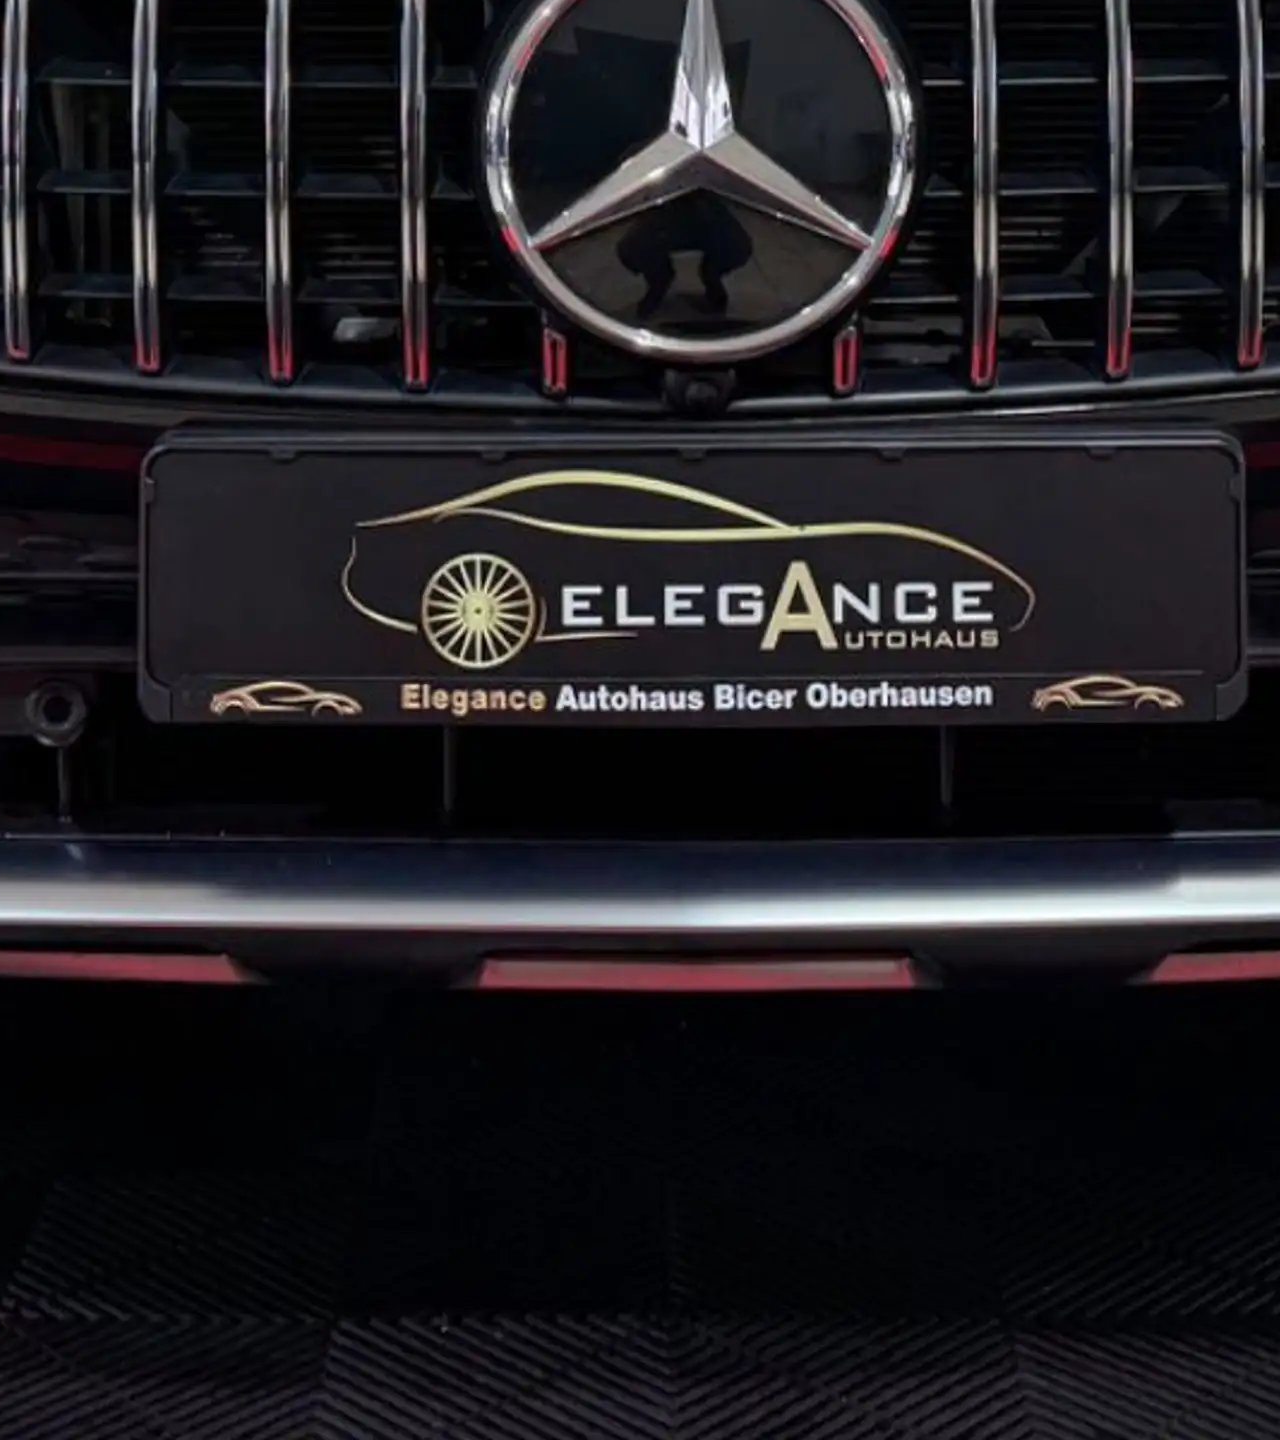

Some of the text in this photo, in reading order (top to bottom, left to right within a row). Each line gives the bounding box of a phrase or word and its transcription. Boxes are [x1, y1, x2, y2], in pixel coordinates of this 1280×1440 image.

[561, 560, 994, 651] ELEGANCE
[400, 681, 994, 717] Elegance Autohaus Bicer Oberhausen
